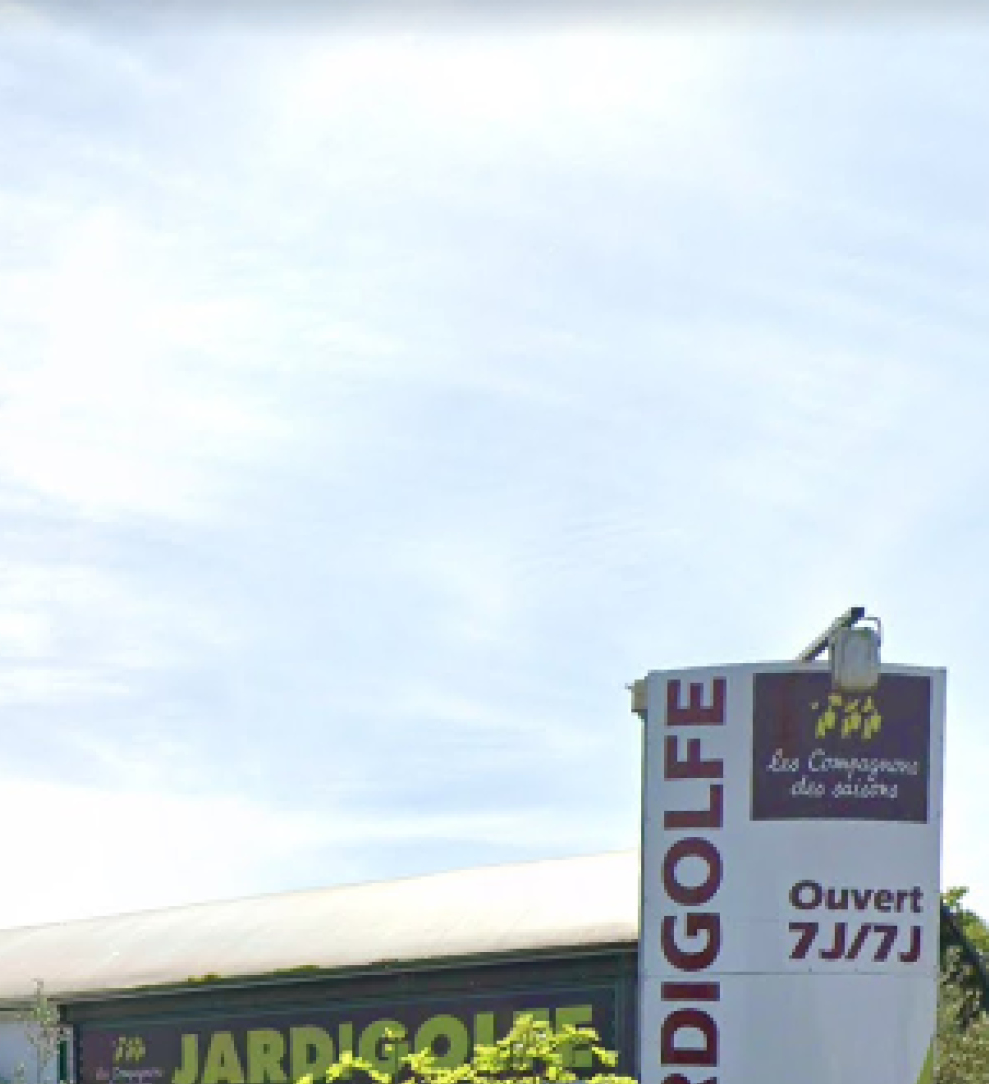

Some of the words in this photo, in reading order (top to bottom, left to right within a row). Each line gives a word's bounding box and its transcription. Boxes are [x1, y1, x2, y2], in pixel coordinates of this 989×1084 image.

[790, 775, 825, 798] des
[788, 880, 924, 914] Ouvert
[788, 922, 922, 963] 7J/7J
